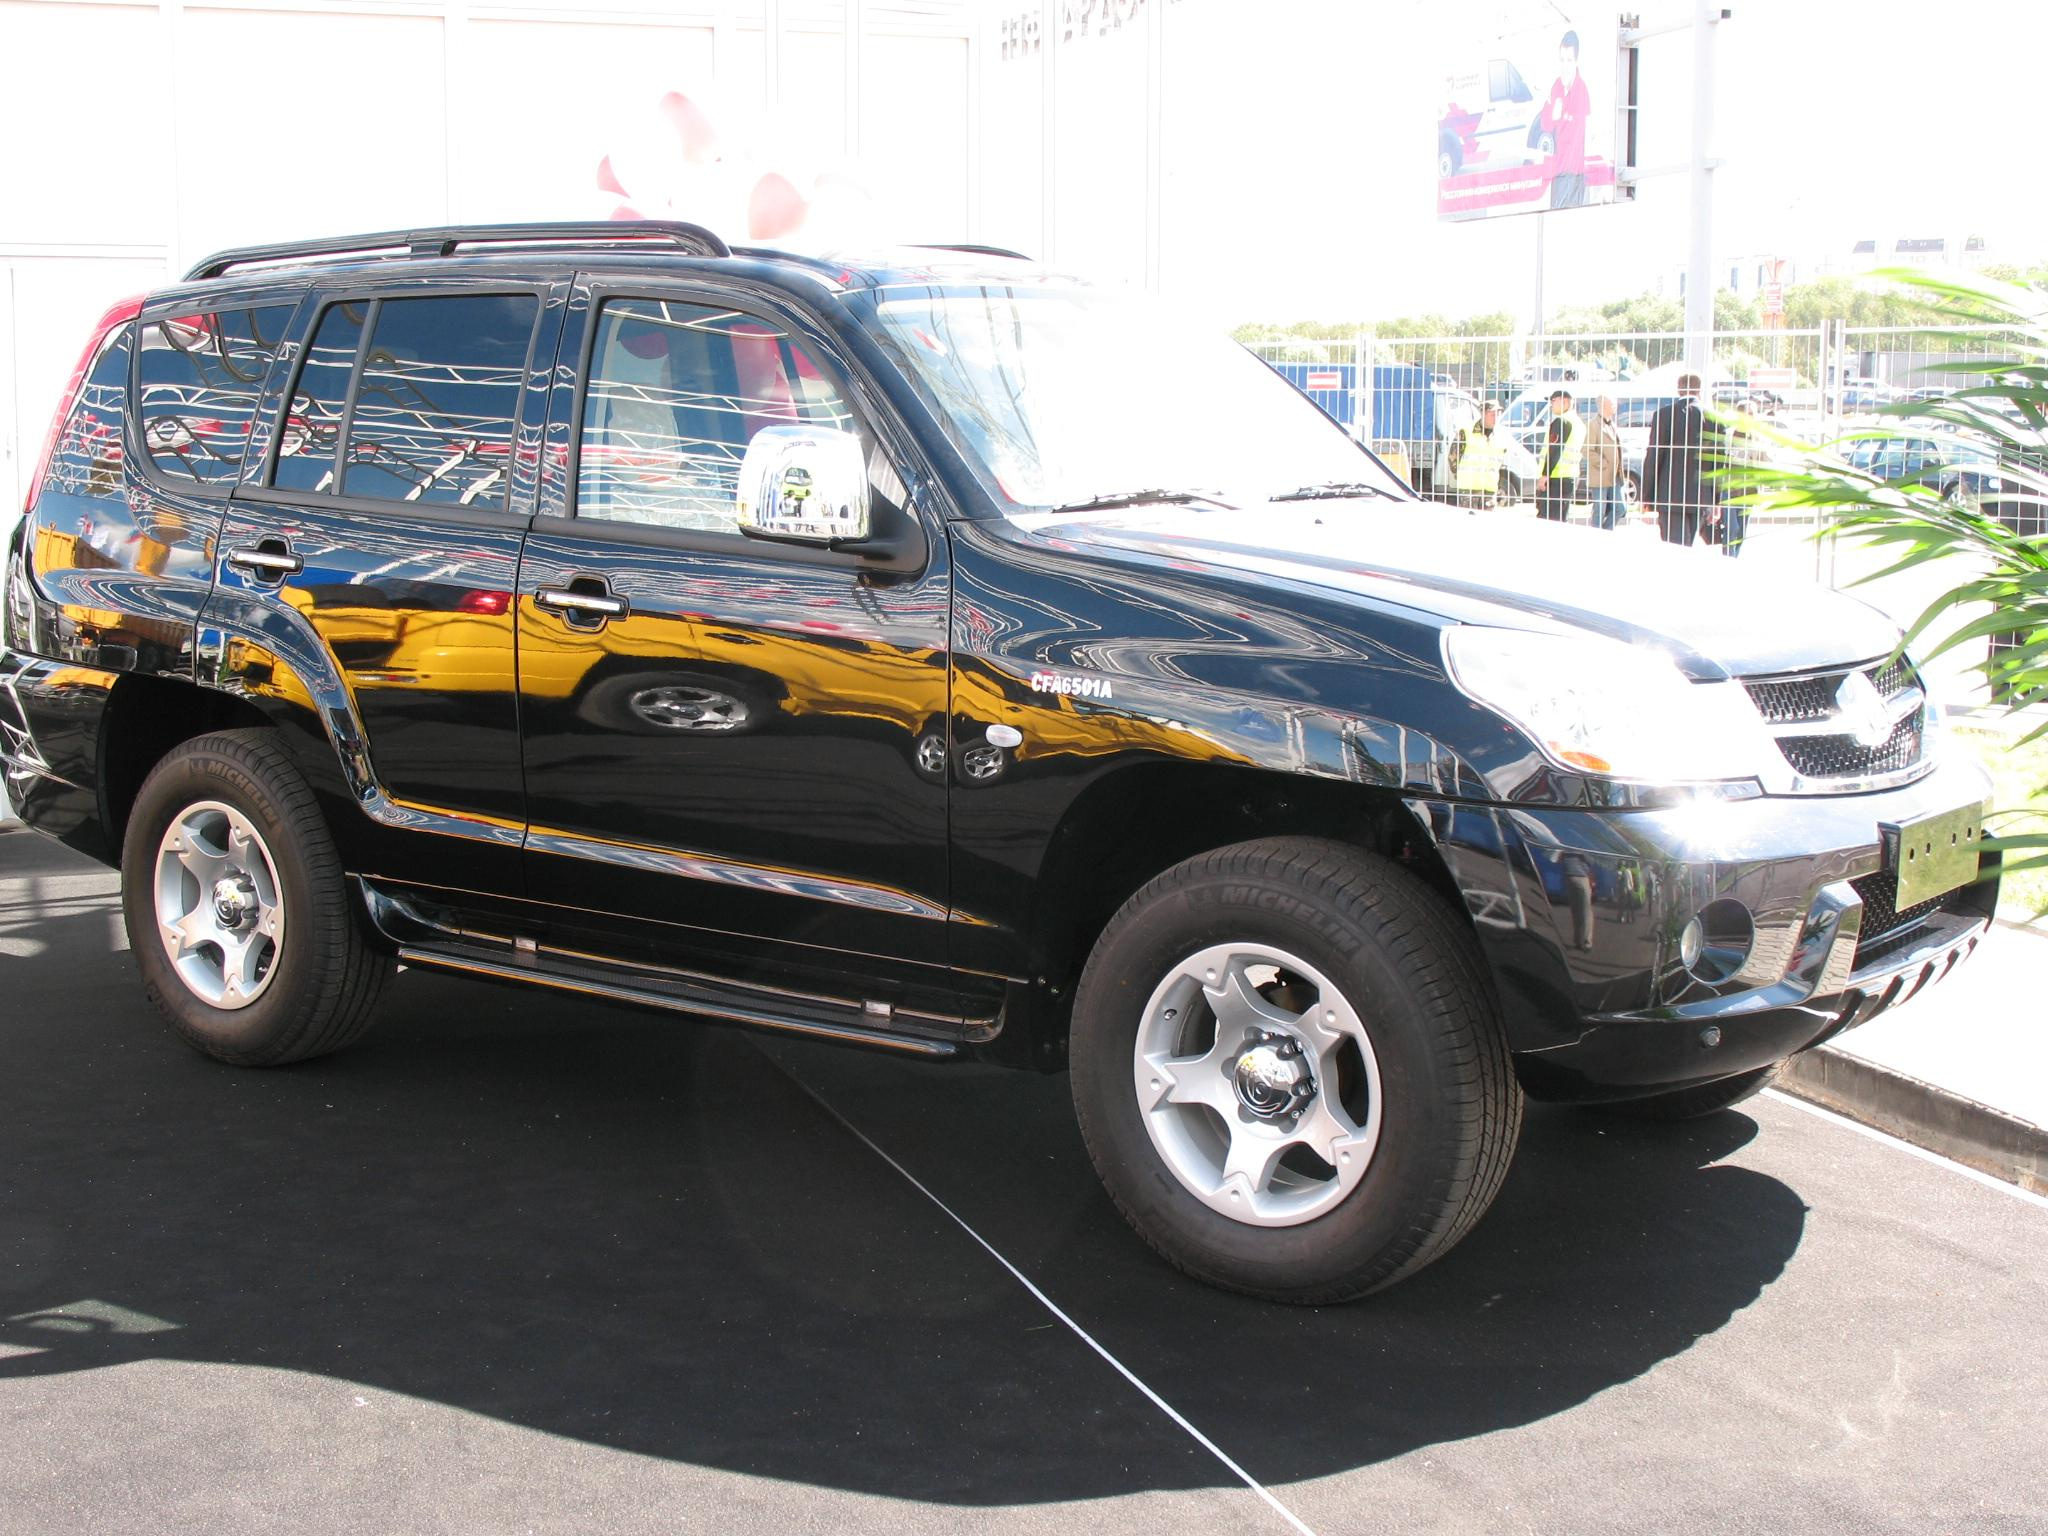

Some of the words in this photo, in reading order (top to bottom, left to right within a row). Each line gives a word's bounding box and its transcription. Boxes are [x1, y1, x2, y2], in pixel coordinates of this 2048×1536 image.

[1031, 673, 1113, 699] CFA6501A
[207, 760, 278, 824] MICHELIN
[1221, 885, 1361, 953] MICHELIN
